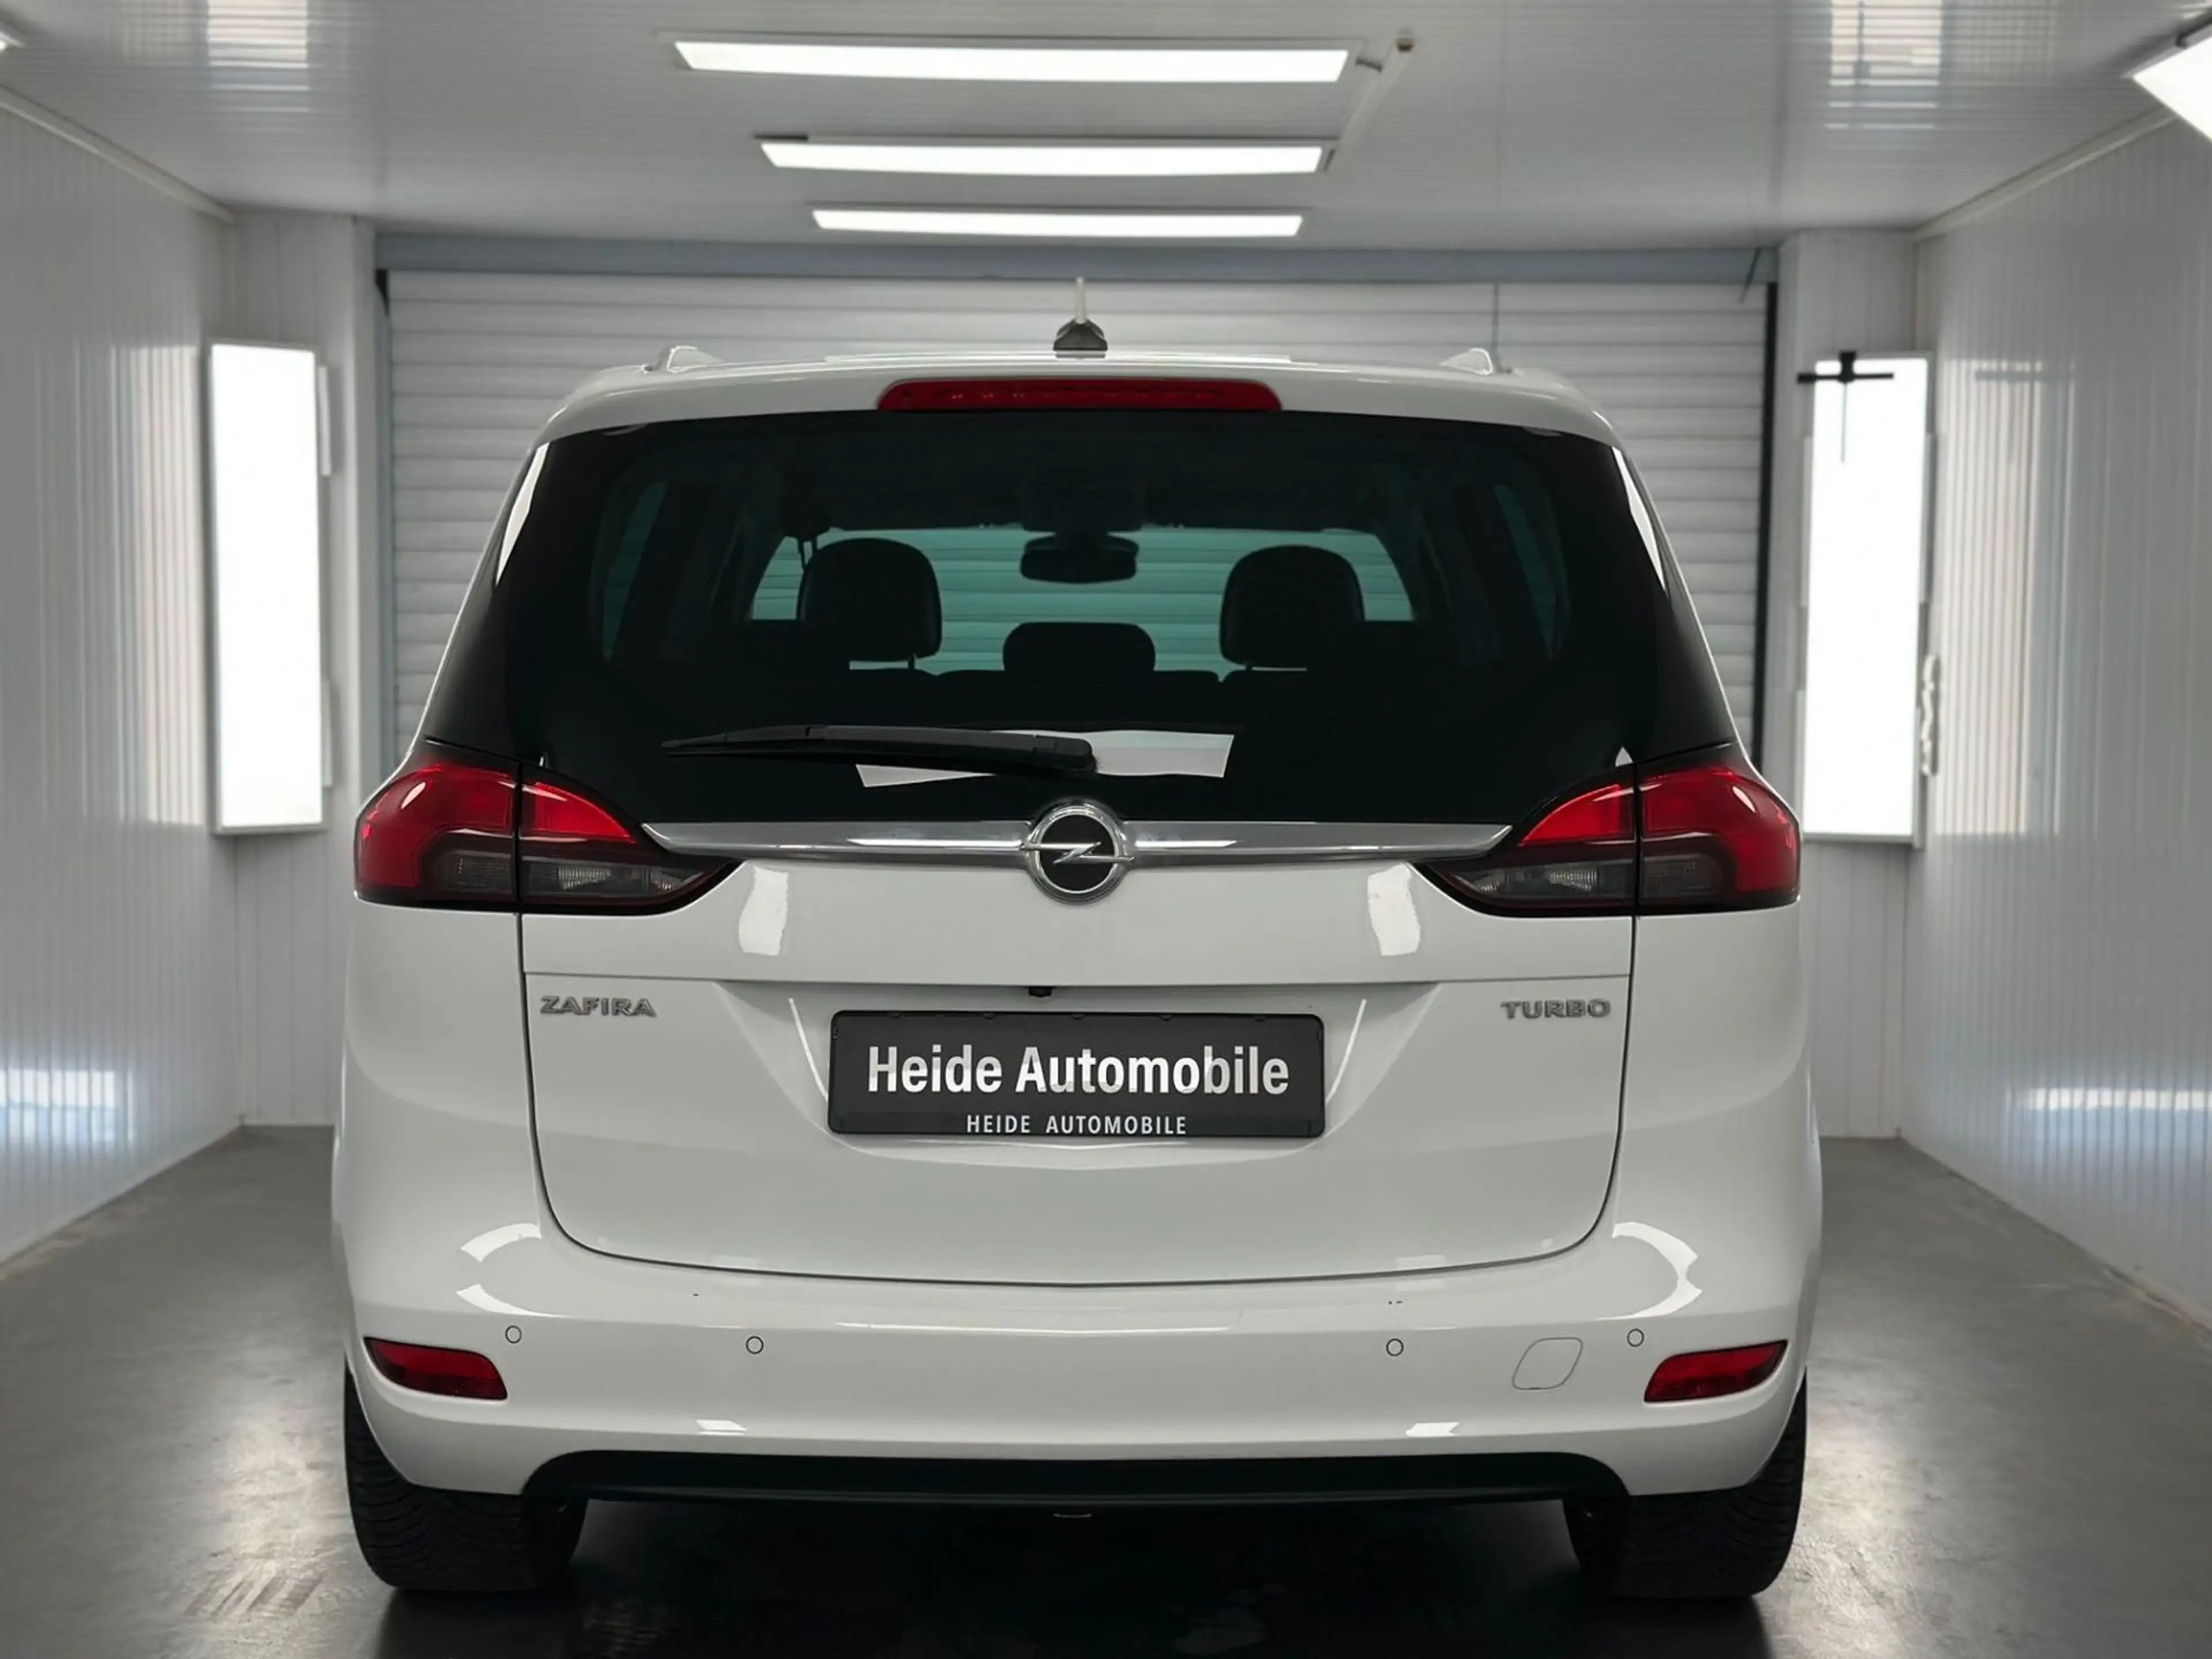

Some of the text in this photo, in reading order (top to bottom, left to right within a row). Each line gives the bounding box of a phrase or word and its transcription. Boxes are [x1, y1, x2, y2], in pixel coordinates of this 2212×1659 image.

[540, 995, 657, 1017] ZAFIRA
[1500, 998, 1611, 1020] TURBO
[868, 1044, 1289, 1094] Heide Automobile
[966, 1115, 1187, 1135] HEIDE AUTOMOBILE
